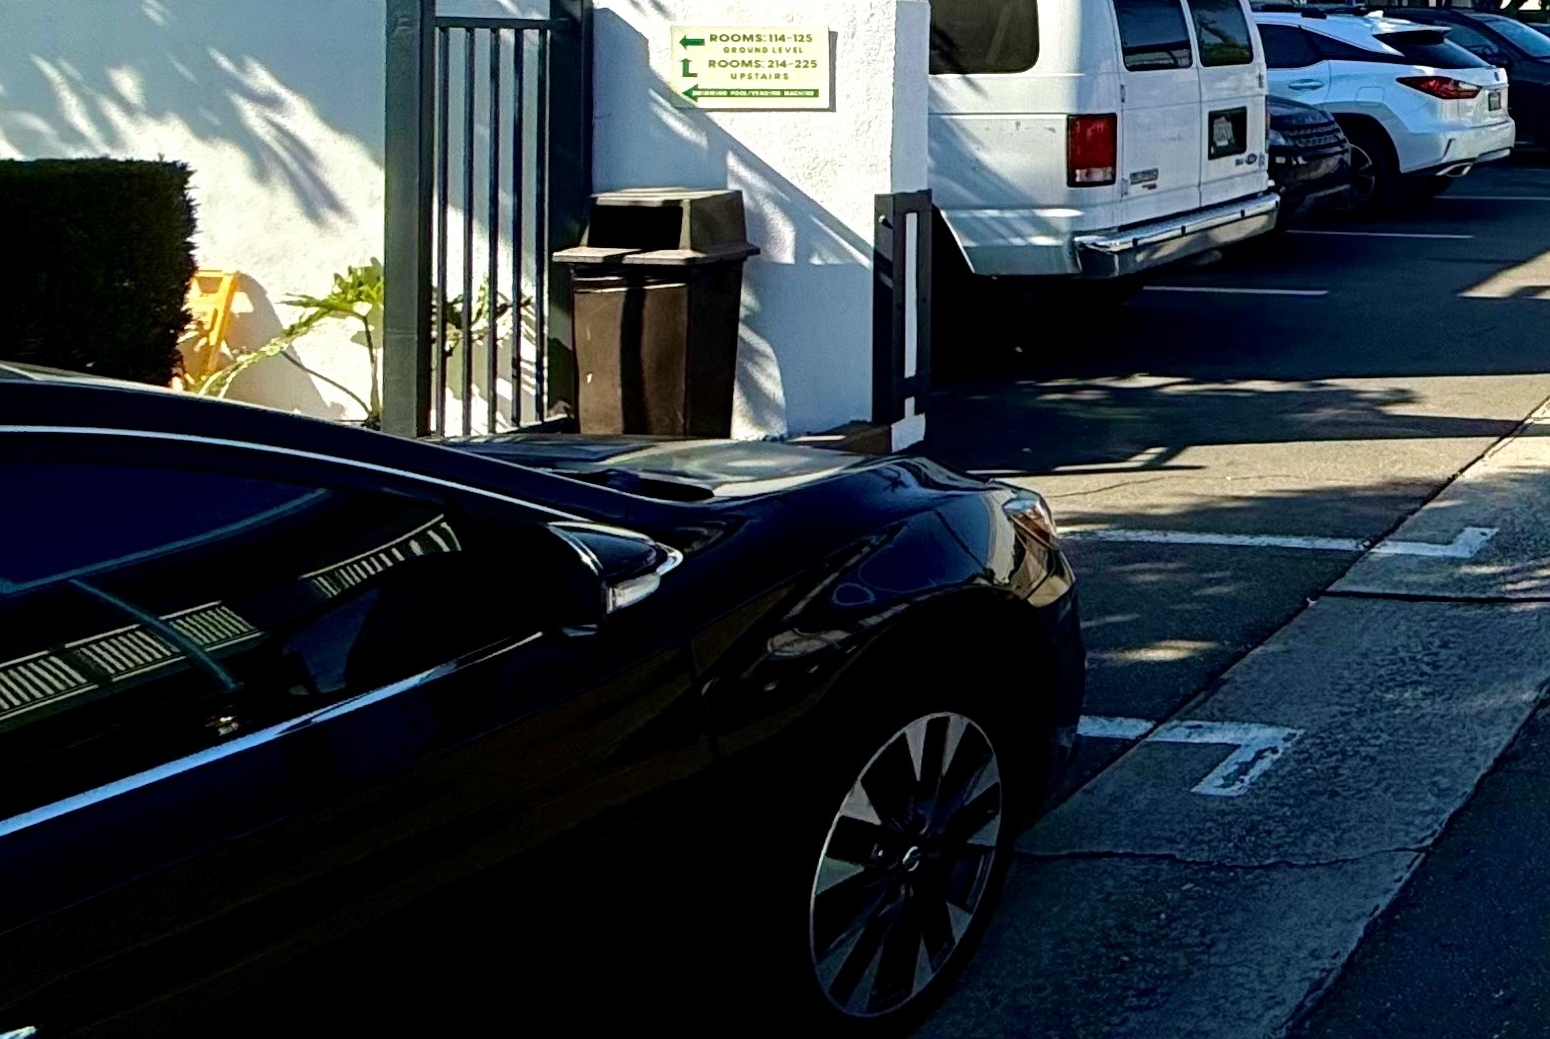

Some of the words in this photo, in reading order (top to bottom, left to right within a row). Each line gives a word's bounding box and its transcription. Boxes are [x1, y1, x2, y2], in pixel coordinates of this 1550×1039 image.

[768, 33, 813, 43] 114-125
[723, 46, 769, 54] GROUND
[771, 46, 804, 54] LEVEL
[767, 59, 818, 69] 214-225
[730, 72, 789, 80] UPSTAIRS
